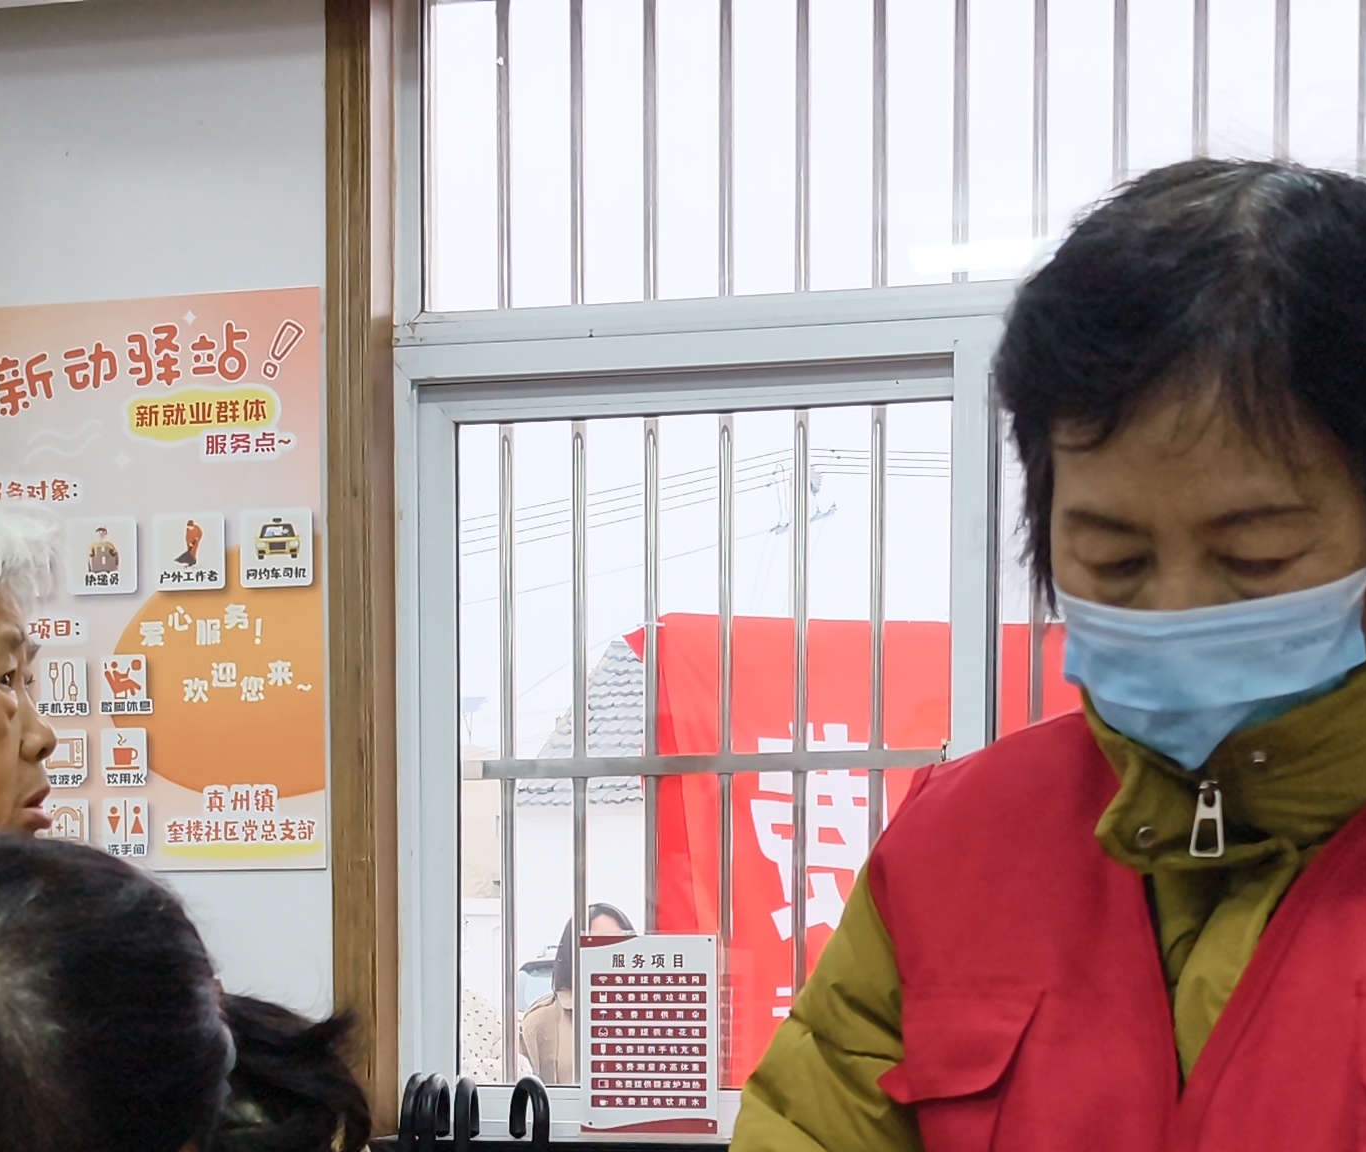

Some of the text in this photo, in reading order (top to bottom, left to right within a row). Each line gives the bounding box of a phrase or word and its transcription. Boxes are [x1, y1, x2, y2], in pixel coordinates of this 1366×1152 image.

[134, 399, 268, 428] 新就业群体
[84, 573, 120, 587] 快递员
[159, 570, 219, 585] 户外工作者
[245, 566, 308, 581] 网约车司机
[37, 702, 89, 715] 手机充电
[106, 773, 145, 785] 饮用水
[206, 788, 276, 813] 真州镇
[166, 819, 317, 844] 奎楼社区党总支部
[108, 844, 145, 856] 洗手间
[611, 953, 686, 969] 服务项目
